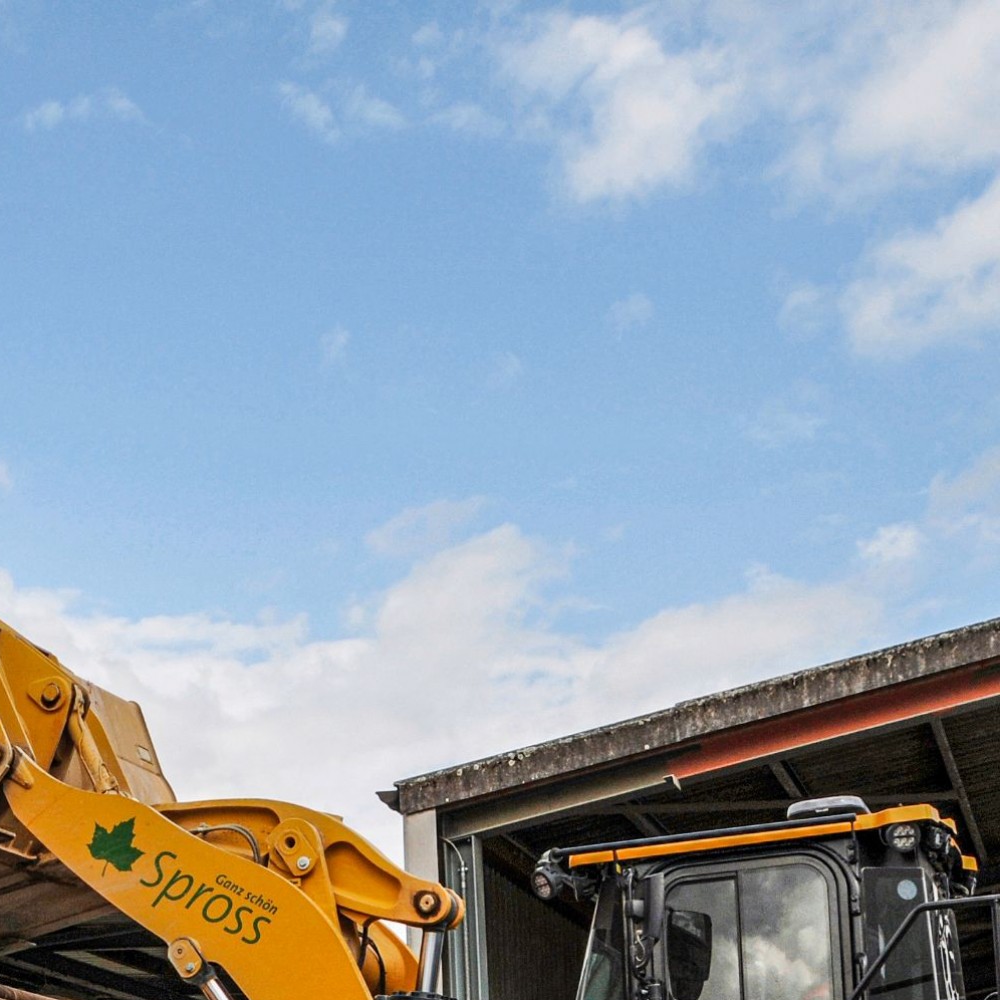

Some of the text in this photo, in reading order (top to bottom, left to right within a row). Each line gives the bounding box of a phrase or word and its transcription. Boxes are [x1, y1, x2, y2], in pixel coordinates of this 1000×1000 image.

[140, 851, 271, 944] Spross
[215, 874, 278, 915] Ganz schön
